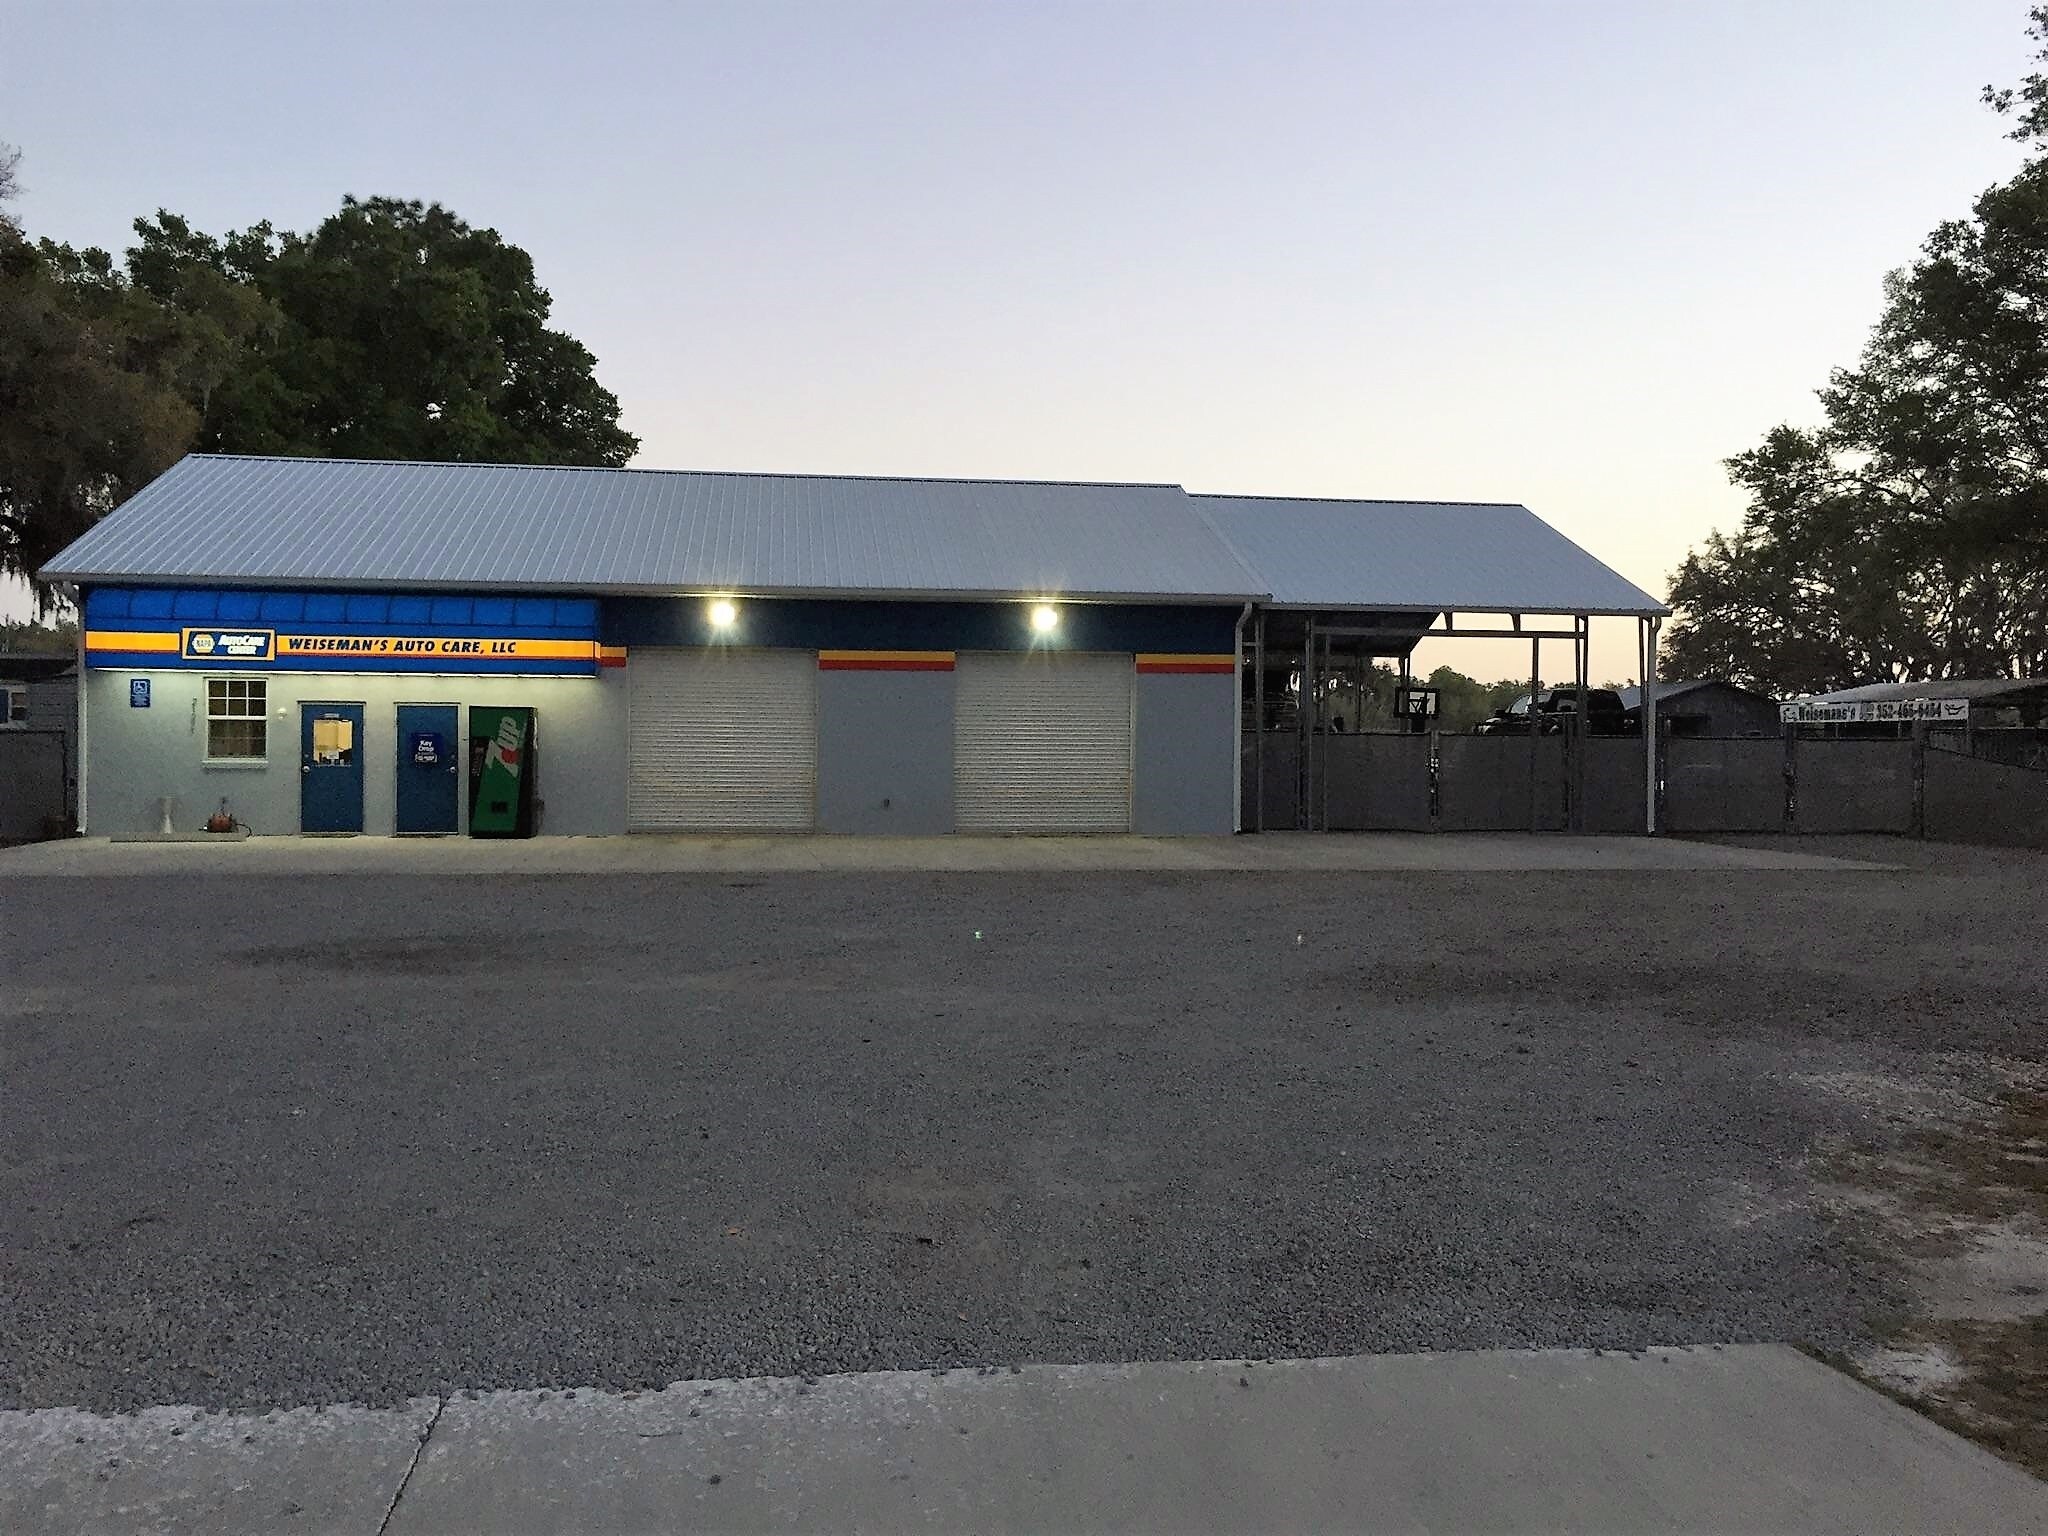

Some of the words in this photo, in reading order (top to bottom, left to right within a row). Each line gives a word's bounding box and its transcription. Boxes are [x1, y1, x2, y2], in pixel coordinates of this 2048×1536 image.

[288, 638, 388, 651] WEISEMAN'S
[393, 640, 435, 652] AUTO
[441, 641, 485, 654] CARE,
[491, 642, 516, 653] LLC
